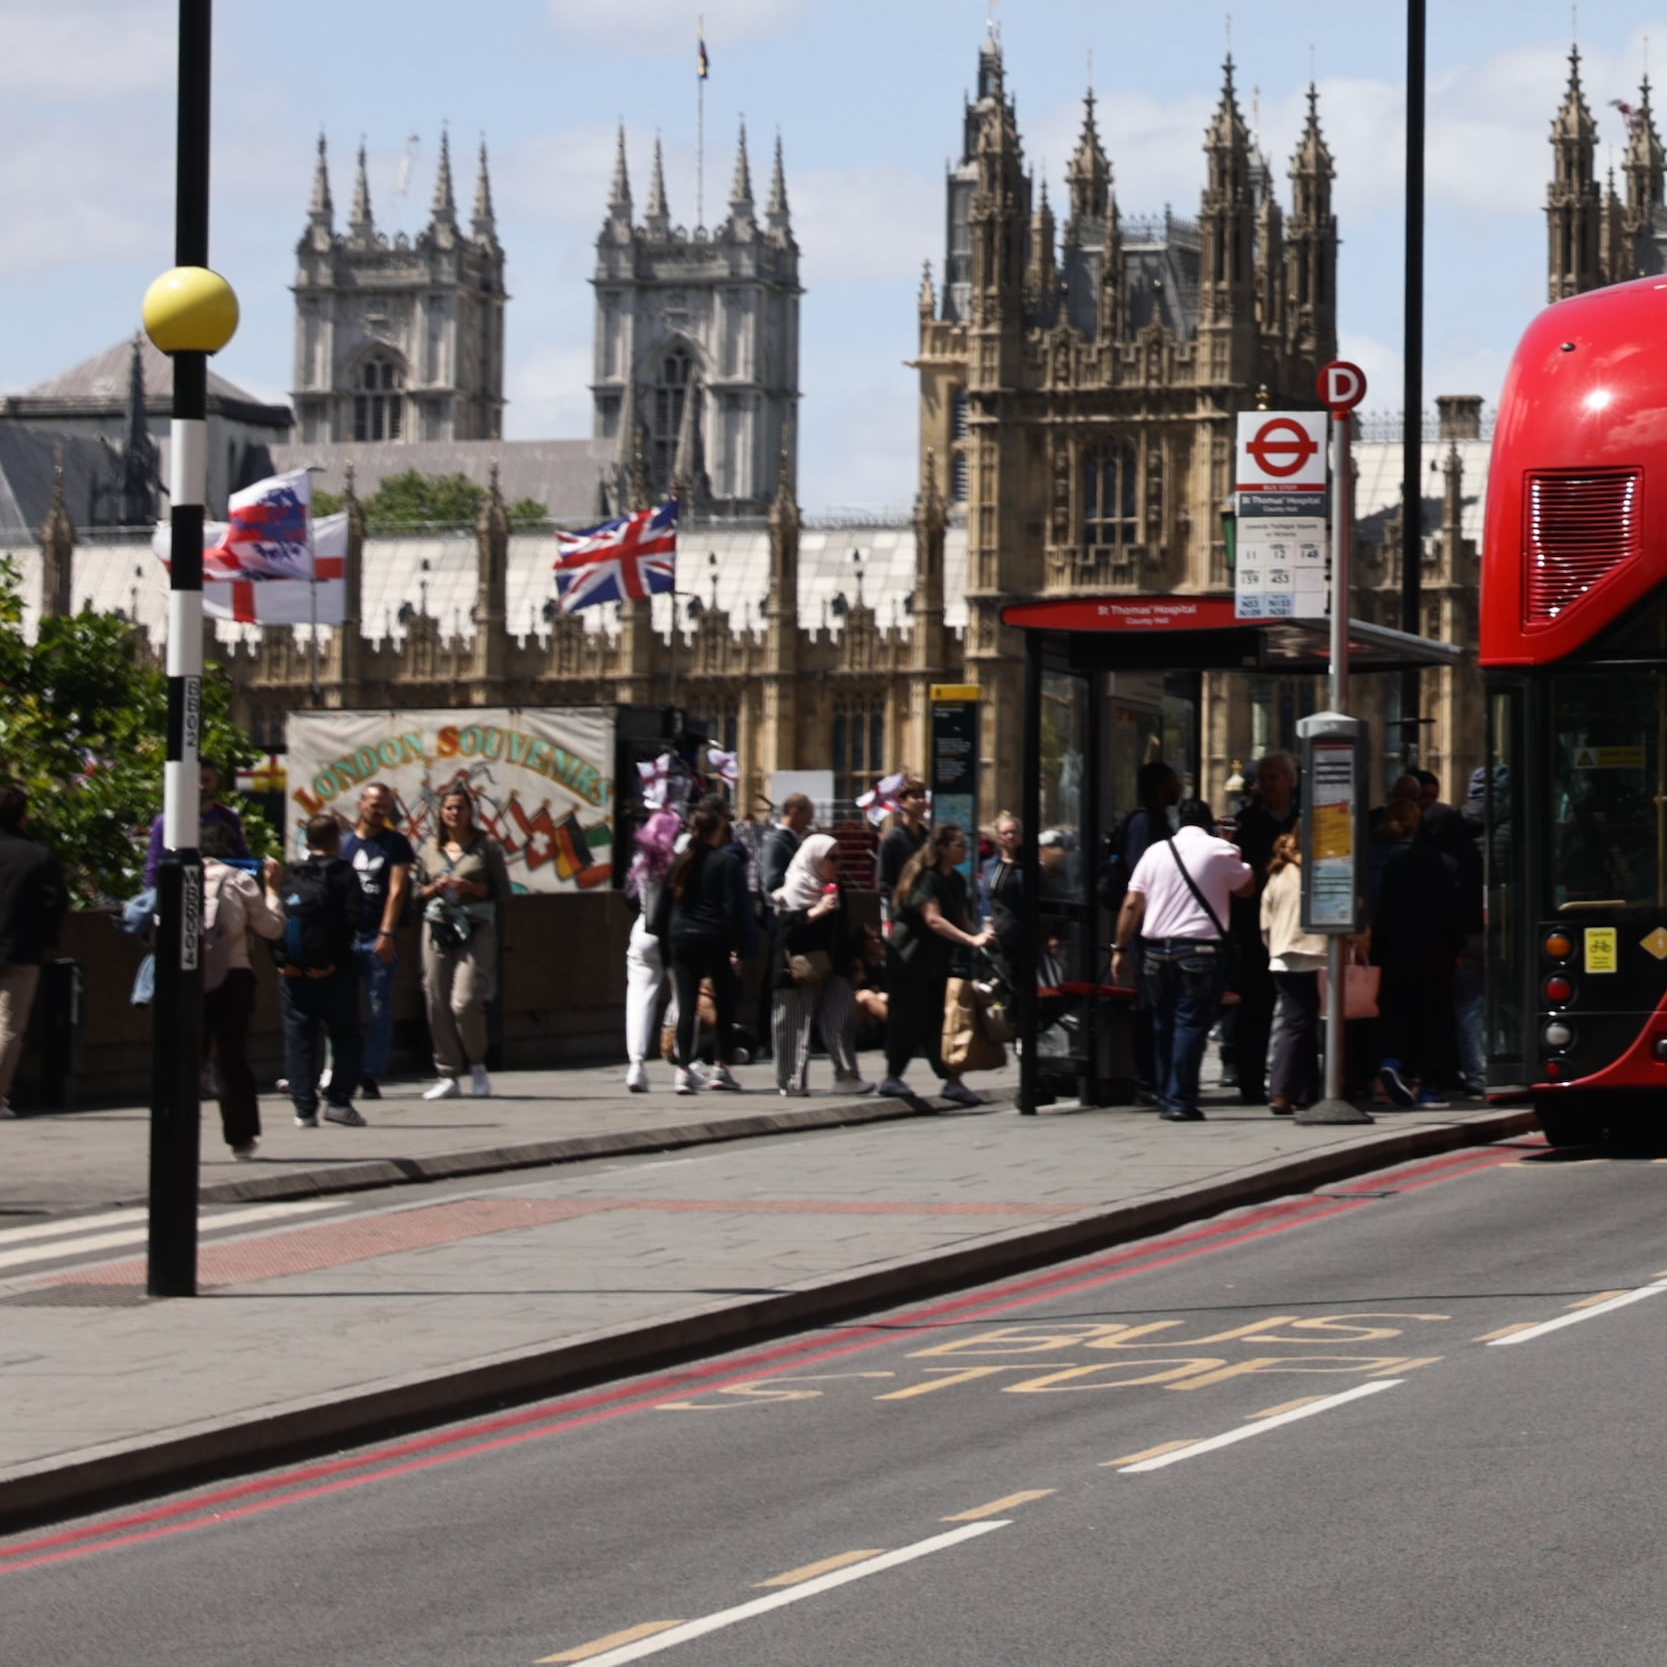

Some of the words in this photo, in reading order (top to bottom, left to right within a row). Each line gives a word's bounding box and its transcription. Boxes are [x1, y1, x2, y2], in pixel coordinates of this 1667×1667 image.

[1328, 368, 1359, 403] D
[292, 730, 424, 815] LONDON
[437, 725, 615, 808] SOUVENIRS
[906, 1313, 1453, 1358] BUS
[655, 1354, 1445, 1410] STOP
